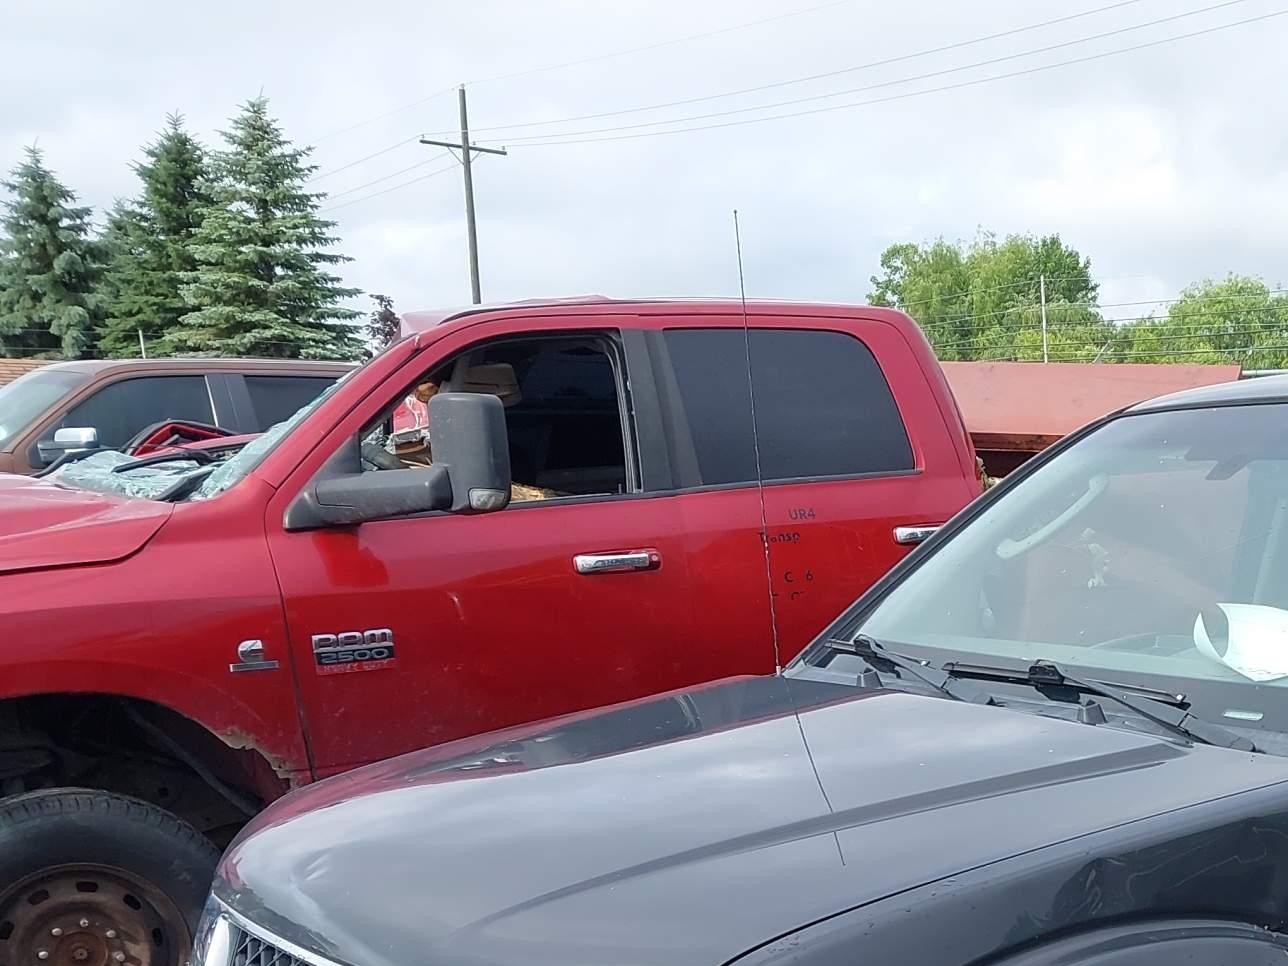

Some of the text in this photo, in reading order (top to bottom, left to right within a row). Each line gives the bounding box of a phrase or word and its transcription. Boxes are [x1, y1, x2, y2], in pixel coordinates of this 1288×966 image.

[788, 508, 816, 520] UR4
[312, 628, 393, 652] RAM
[320, 648, 389, 664] 2500
